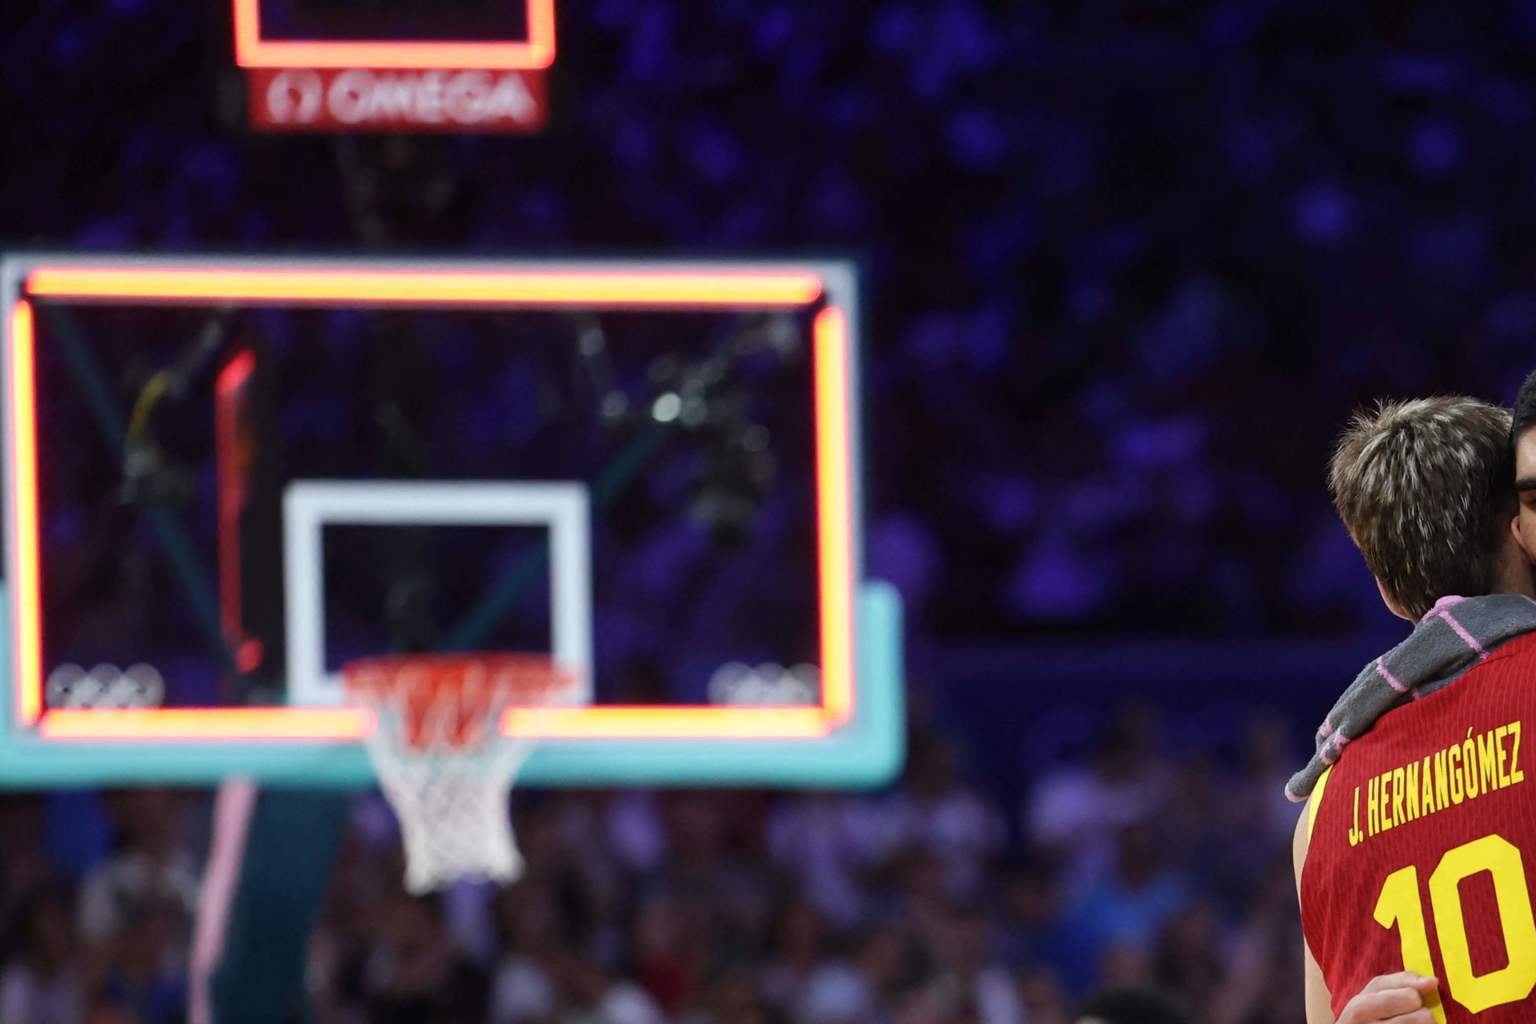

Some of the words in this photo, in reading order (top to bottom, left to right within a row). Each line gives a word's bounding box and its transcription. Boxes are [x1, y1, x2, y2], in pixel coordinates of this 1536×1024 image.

[328, 70, 538, 125] OMEGA
[1349, 786, 1364, 847] J.
[1367, 720, 1524, 838] HERNANGÓMEZ
